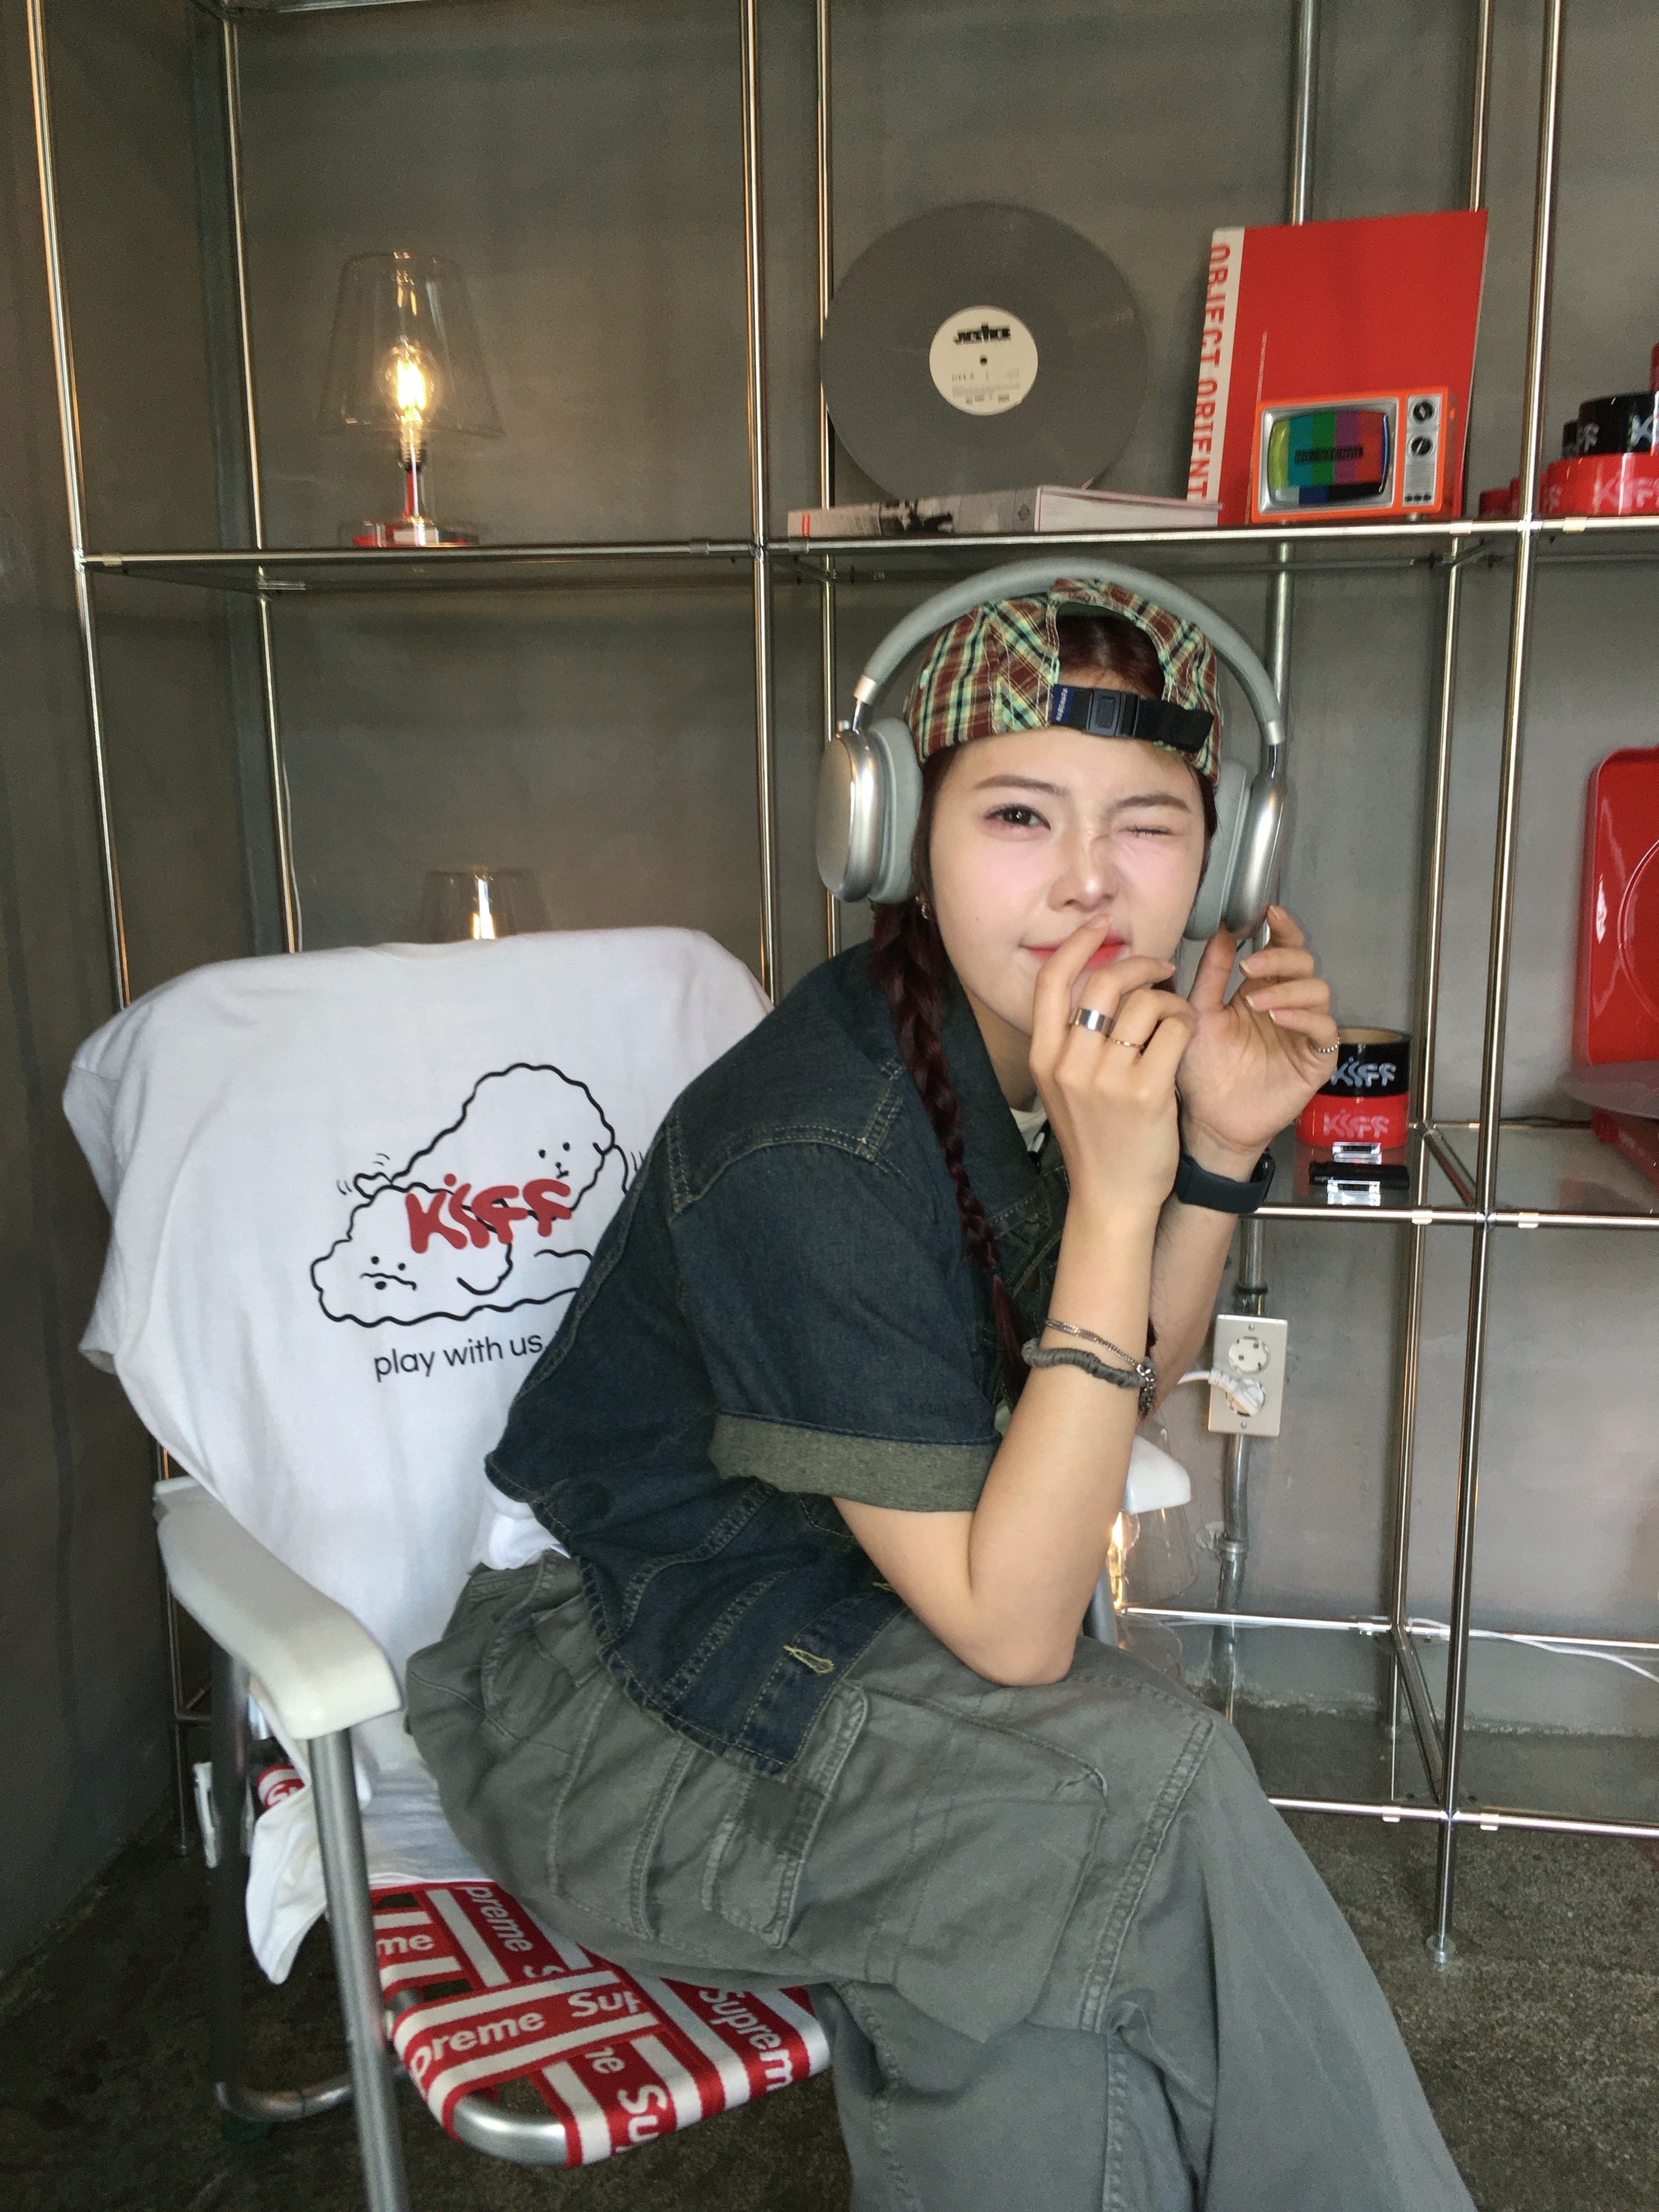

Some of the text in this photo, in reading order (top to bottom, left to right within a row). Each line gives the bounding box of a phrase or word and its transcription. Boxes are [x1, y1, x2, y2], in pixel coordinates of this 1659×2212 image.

[373, 1334, 543, 1382] play with us
